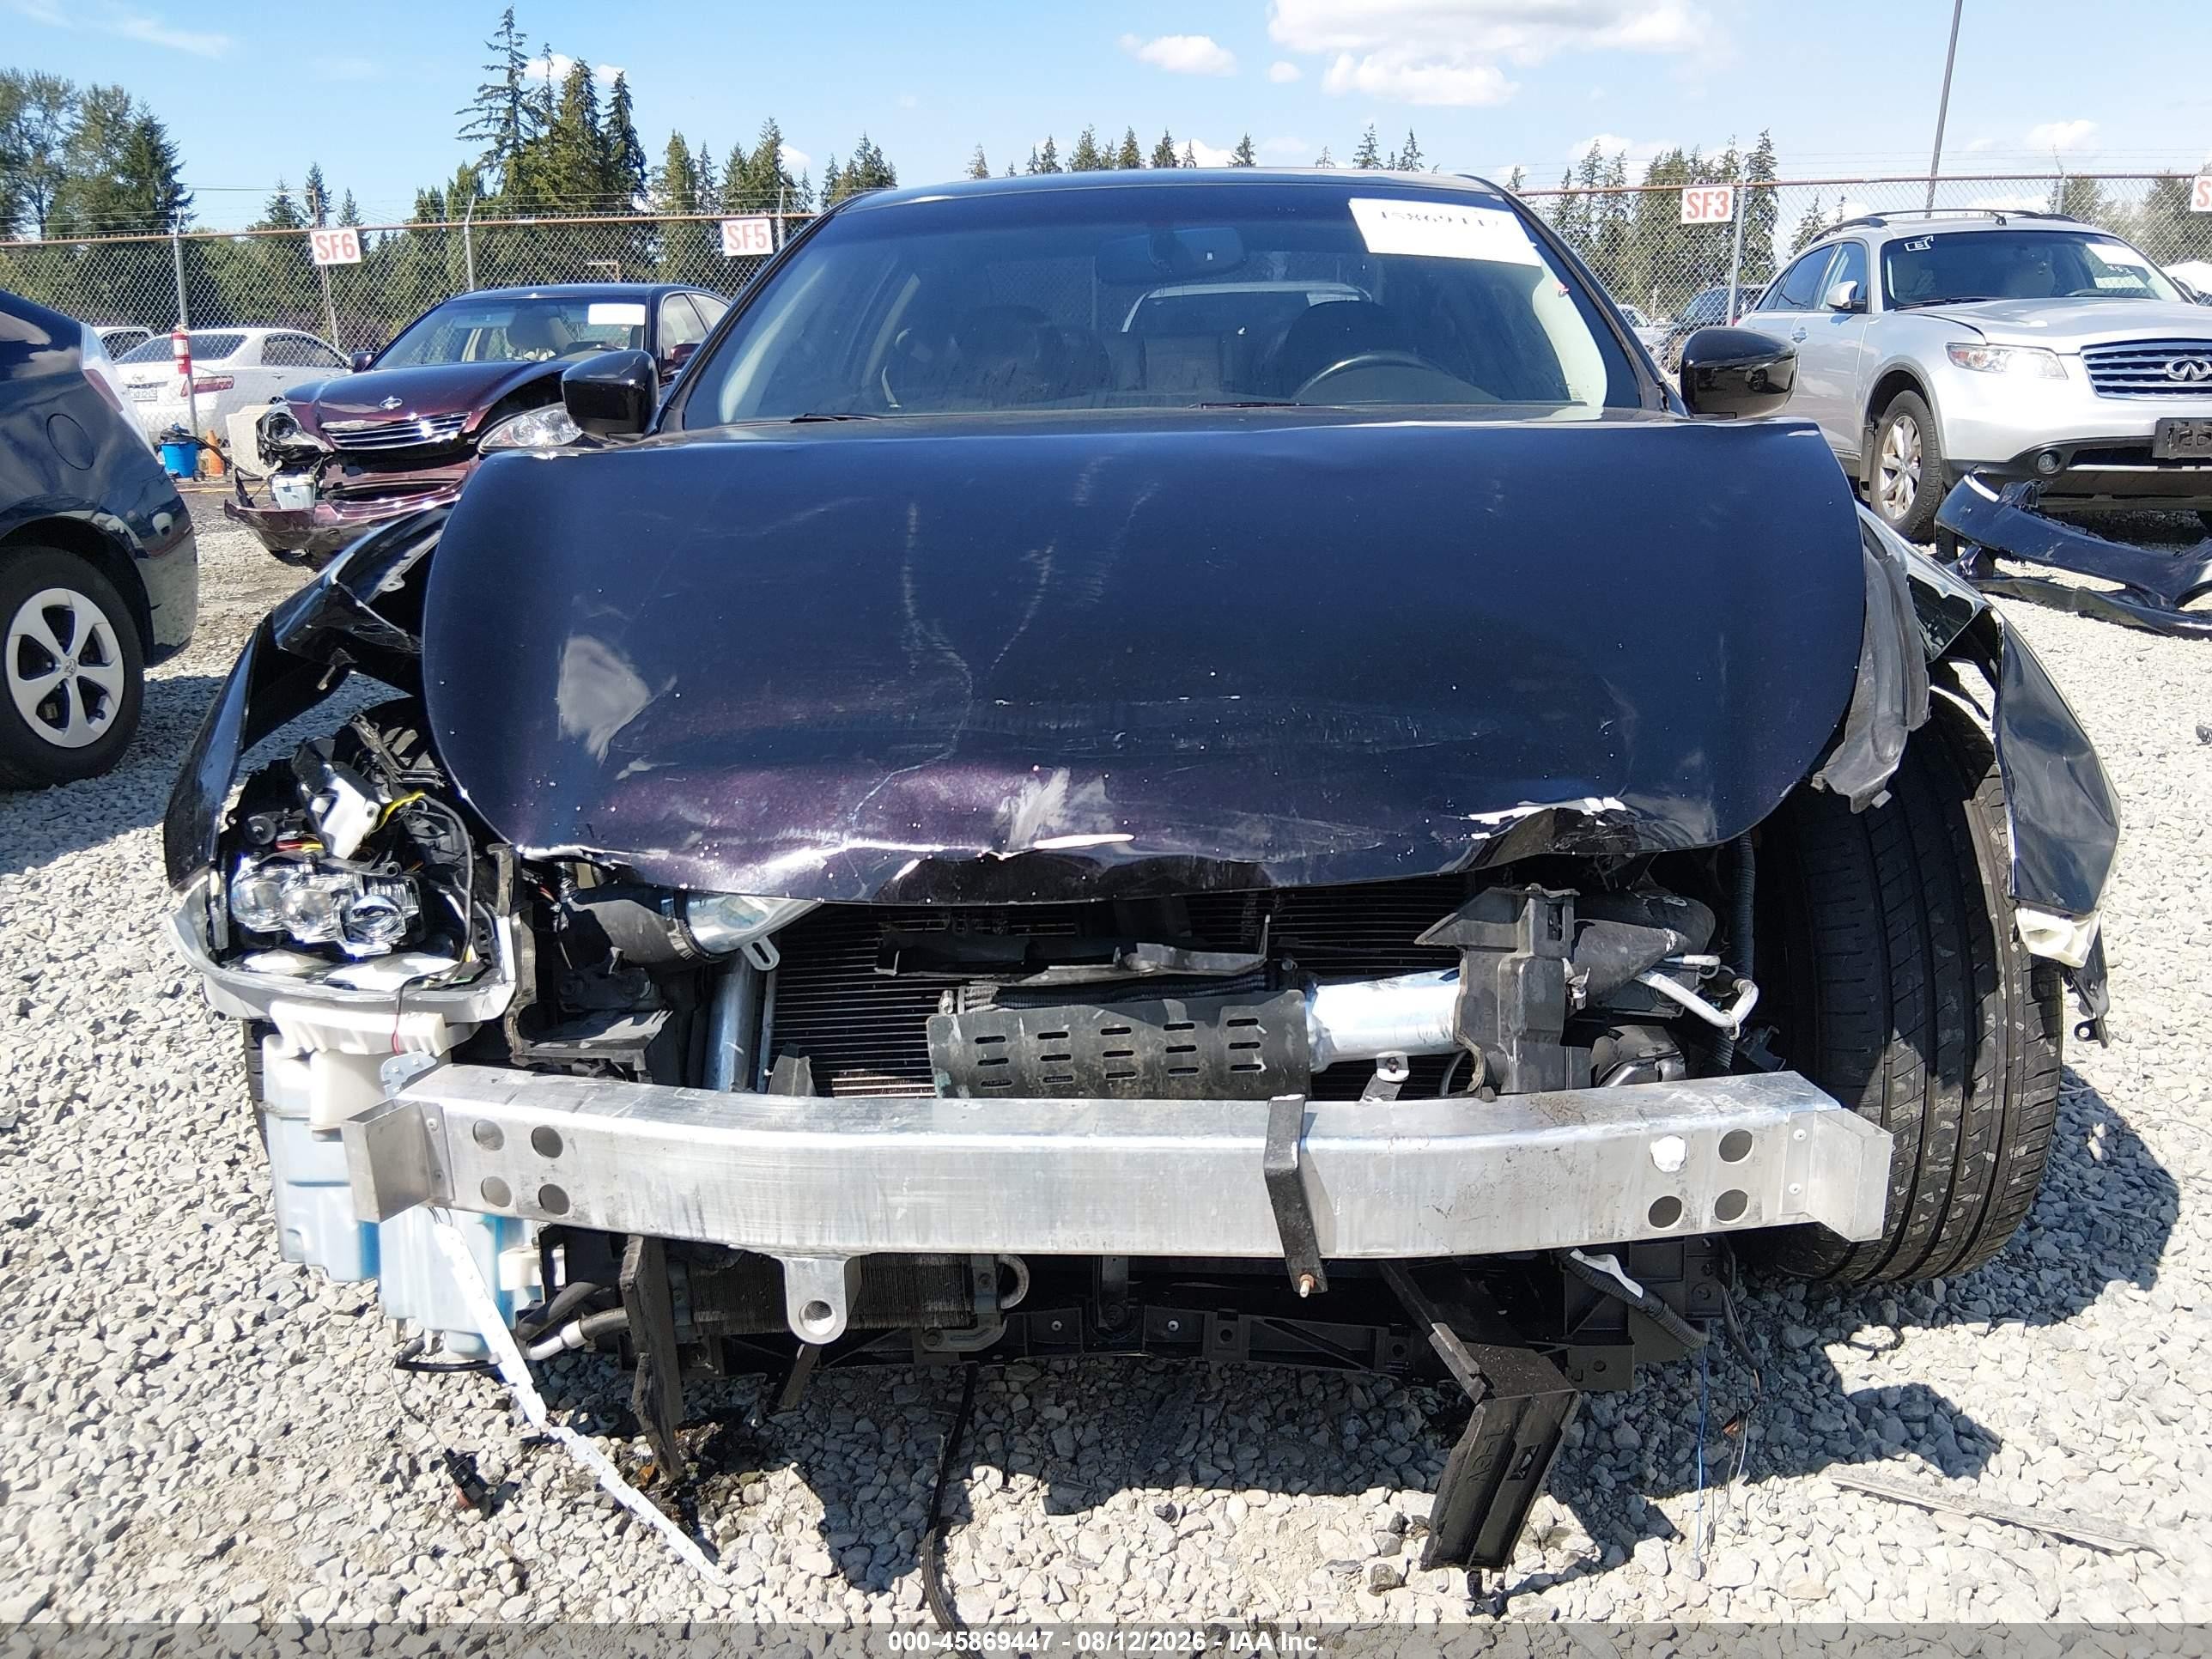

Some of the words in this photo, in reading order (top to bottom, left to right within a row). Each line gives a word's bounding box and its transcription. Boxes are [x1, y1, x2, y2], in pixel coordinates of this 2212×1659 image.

[1686, 191, 1729, 219] SF3
[315, 233, 356, 261] SF6
[726, 222, 768, 251] SF5
